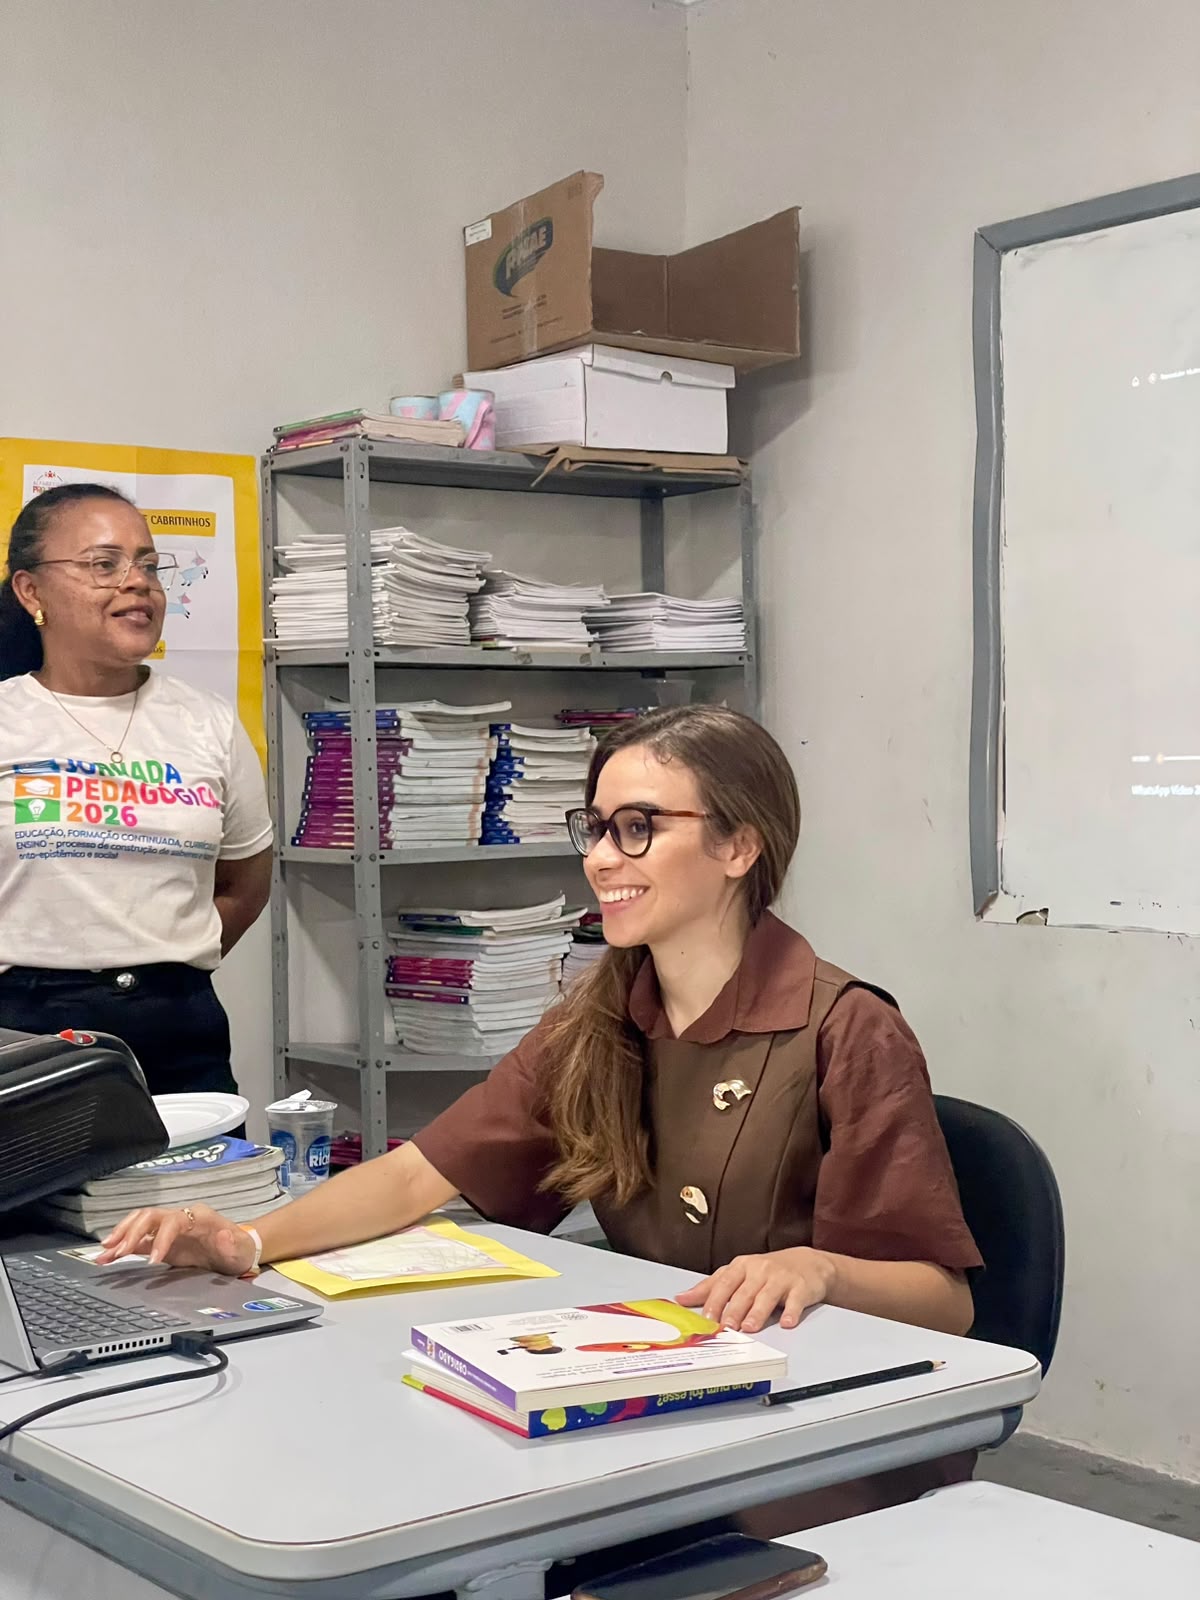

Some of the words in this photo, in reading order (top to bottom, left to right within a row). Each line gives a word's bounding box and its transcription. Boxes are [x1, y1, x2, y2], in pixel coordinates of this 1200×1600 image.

[150, 515, 211, 528] CABRITINHOS
[66, 758, 182, 784] JORNADA
[66, 801, 138, 827] 2026
[15, 827, 65, 839] EDUCAÇÃO,
[68, 829, 119, 843] FORMAÇÃO
[121, 833, 182, 847] CONTINUADA,
[16, 840, 47, 850] ENSINO
[110, 844, 157, 855] construção
[128, 1143, 227, 1169] CONQU
[438, 1350, 468, 1376] OBRIGADO
[657, 1390, 687, 1407] esse?
